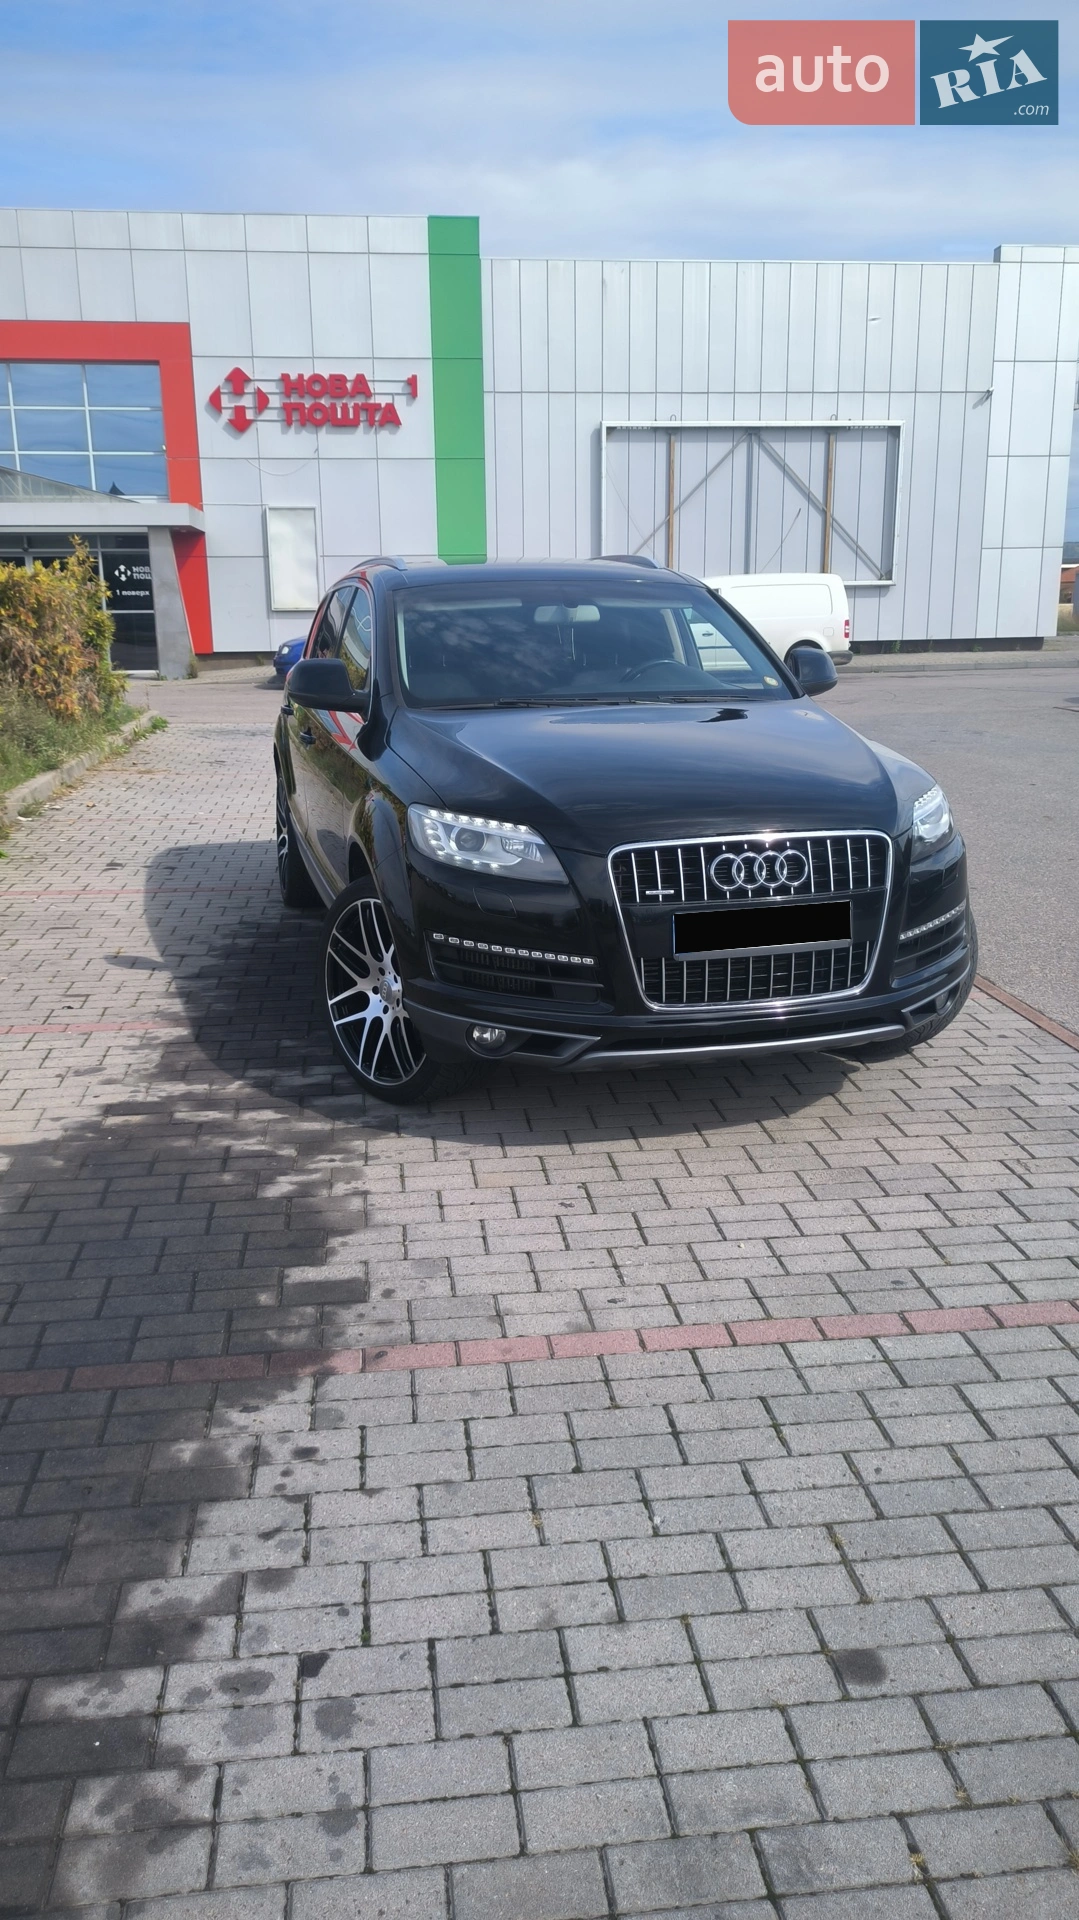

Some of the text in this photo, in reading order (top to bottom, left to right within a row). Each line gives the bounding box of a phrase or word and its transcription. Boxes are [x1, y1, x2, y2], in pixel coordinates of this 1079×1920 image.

[281, 373, 418, 399] НОВА 1
[282, 402, 402, 427] ПОШТА
